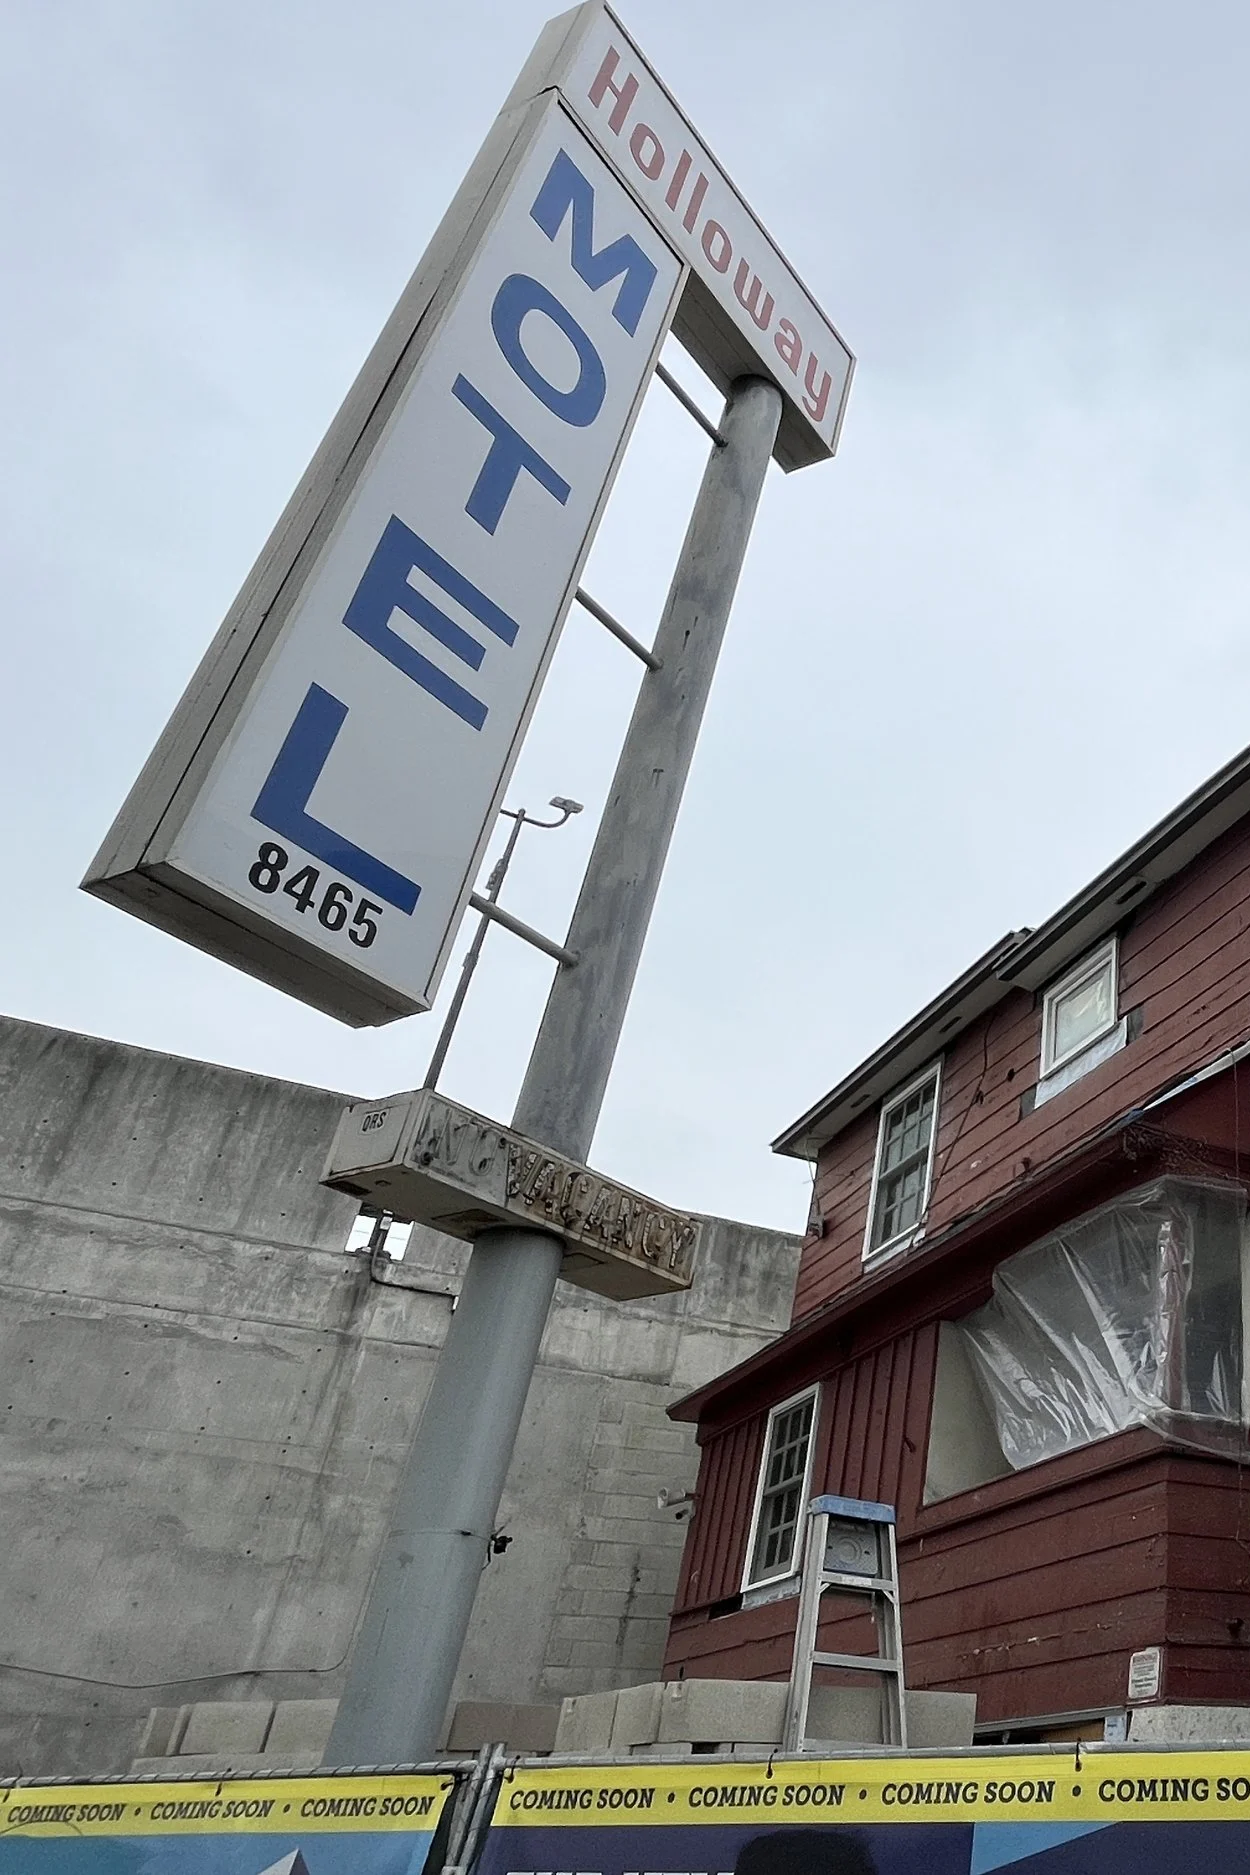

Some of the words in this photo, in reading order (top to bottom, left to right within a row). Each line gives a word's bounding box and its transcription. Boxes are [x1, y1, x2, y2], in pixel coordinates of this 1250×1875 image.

[588, 45, 832, 423] Holloway
[250, 148, 658, 917] MOTEL
[248, 842, 384, 950] 8465
[507, 1142, 696, 1269] VACANCY
[8, 1804, 75, 1823] COMING
[77, 1803, 126, 1822] SOON
[150, 1801, 219, 1820] COMING
[221, 1799, 275, 1818] SOON
[301, 1798, 378, 1817] COMING
[382, 1796, 436, 1816] SOON
[510, 1790, 594, 1810] COMING
[597, 1788, 655, 1809] SOON
[689, 1786, 778, 1808] COMING
[782, 1785, 845, 1806] SOON
[882, 1782, 978, 1805] COMING
[984, 1780, 1056, 1804] SOON
[1099, 1778, 1210, 1802] COMING
